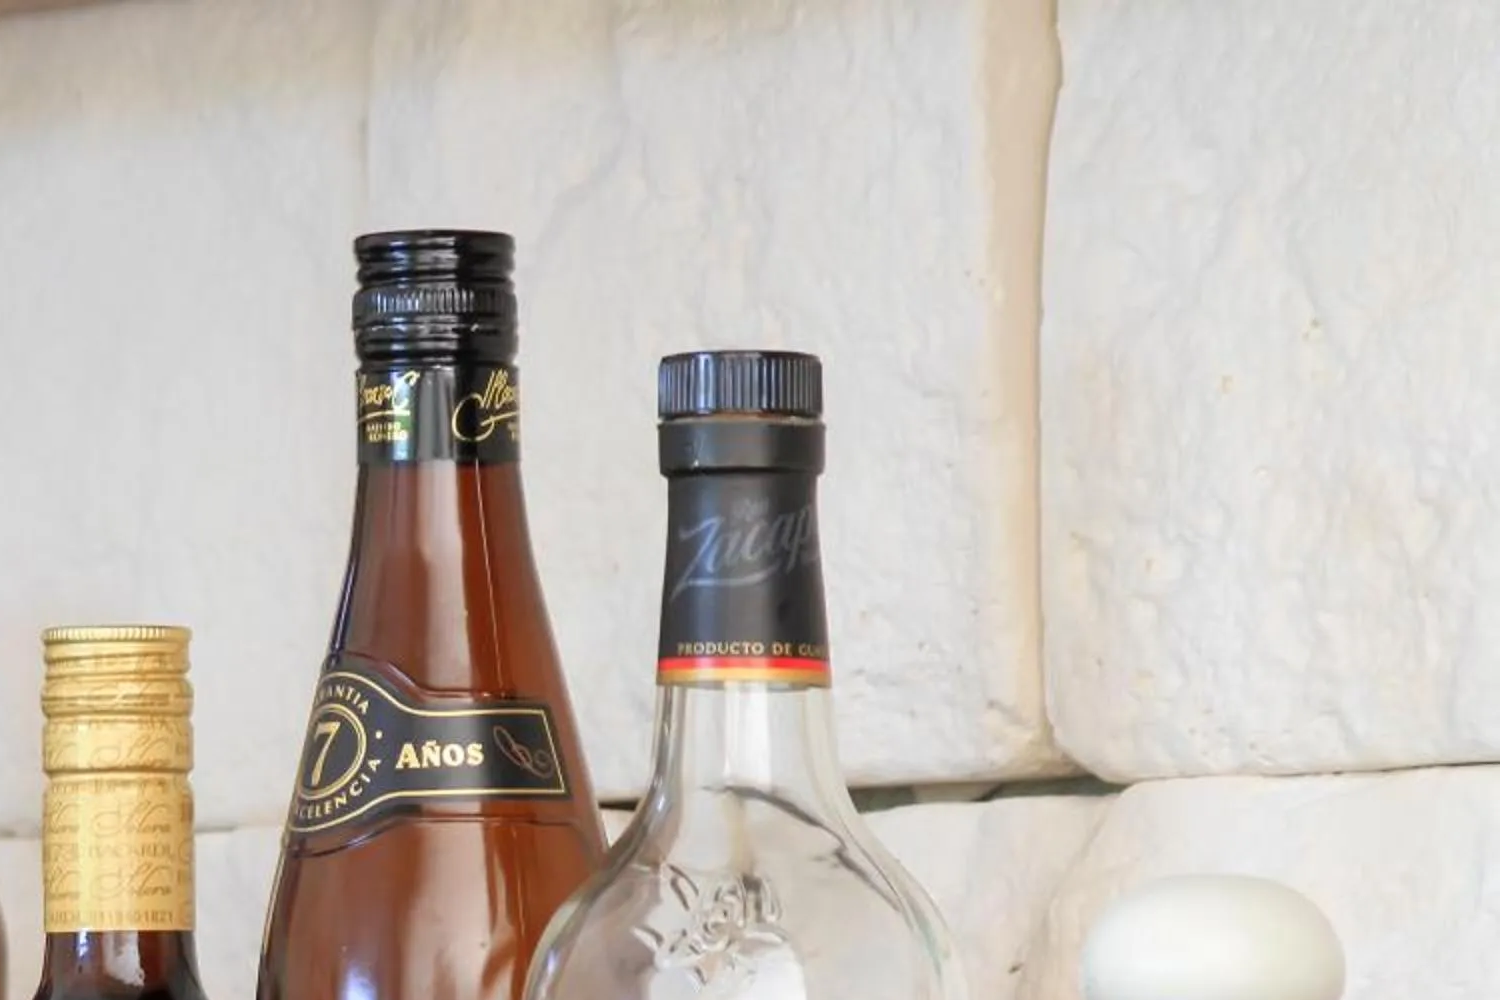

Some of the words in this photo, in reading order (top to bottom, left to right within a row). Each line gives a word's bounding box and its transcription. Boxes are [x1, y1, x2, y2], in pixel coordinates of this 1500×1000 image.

[677, 641, 765, 656] PRODUCTO
[772, 641, 793, 656] DE
[311, 721, 341, 788] 7
[396, 740, 485, 770] AÑOS
